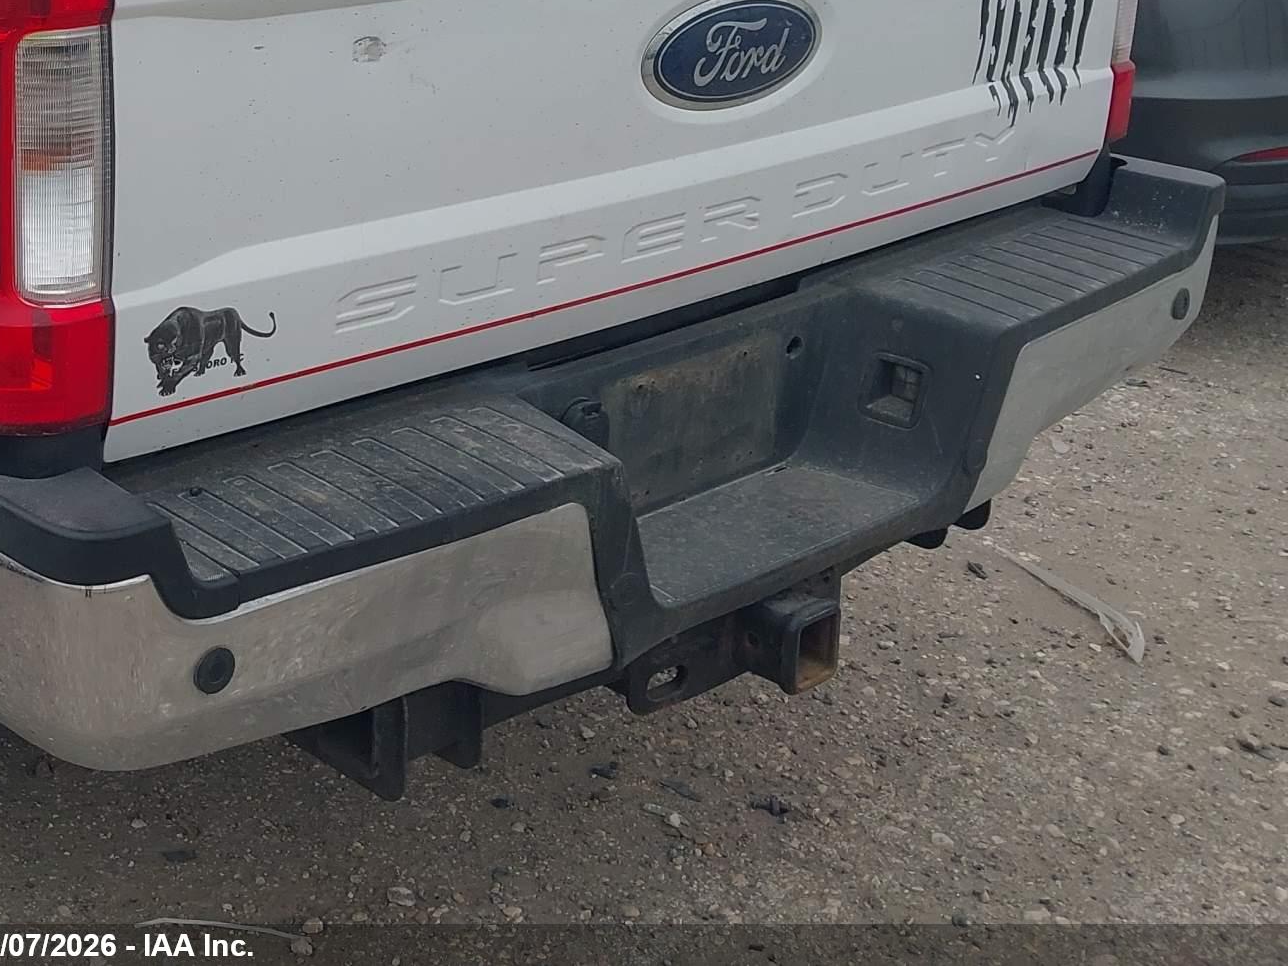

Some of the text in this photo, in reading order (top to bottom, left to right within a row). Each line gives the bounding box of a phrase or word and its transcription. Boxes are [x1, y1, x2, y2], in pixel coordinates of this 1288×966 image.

[693, 17, 789, 87] Ford
[335, 124, 1015, 334] SUPER DUTY
